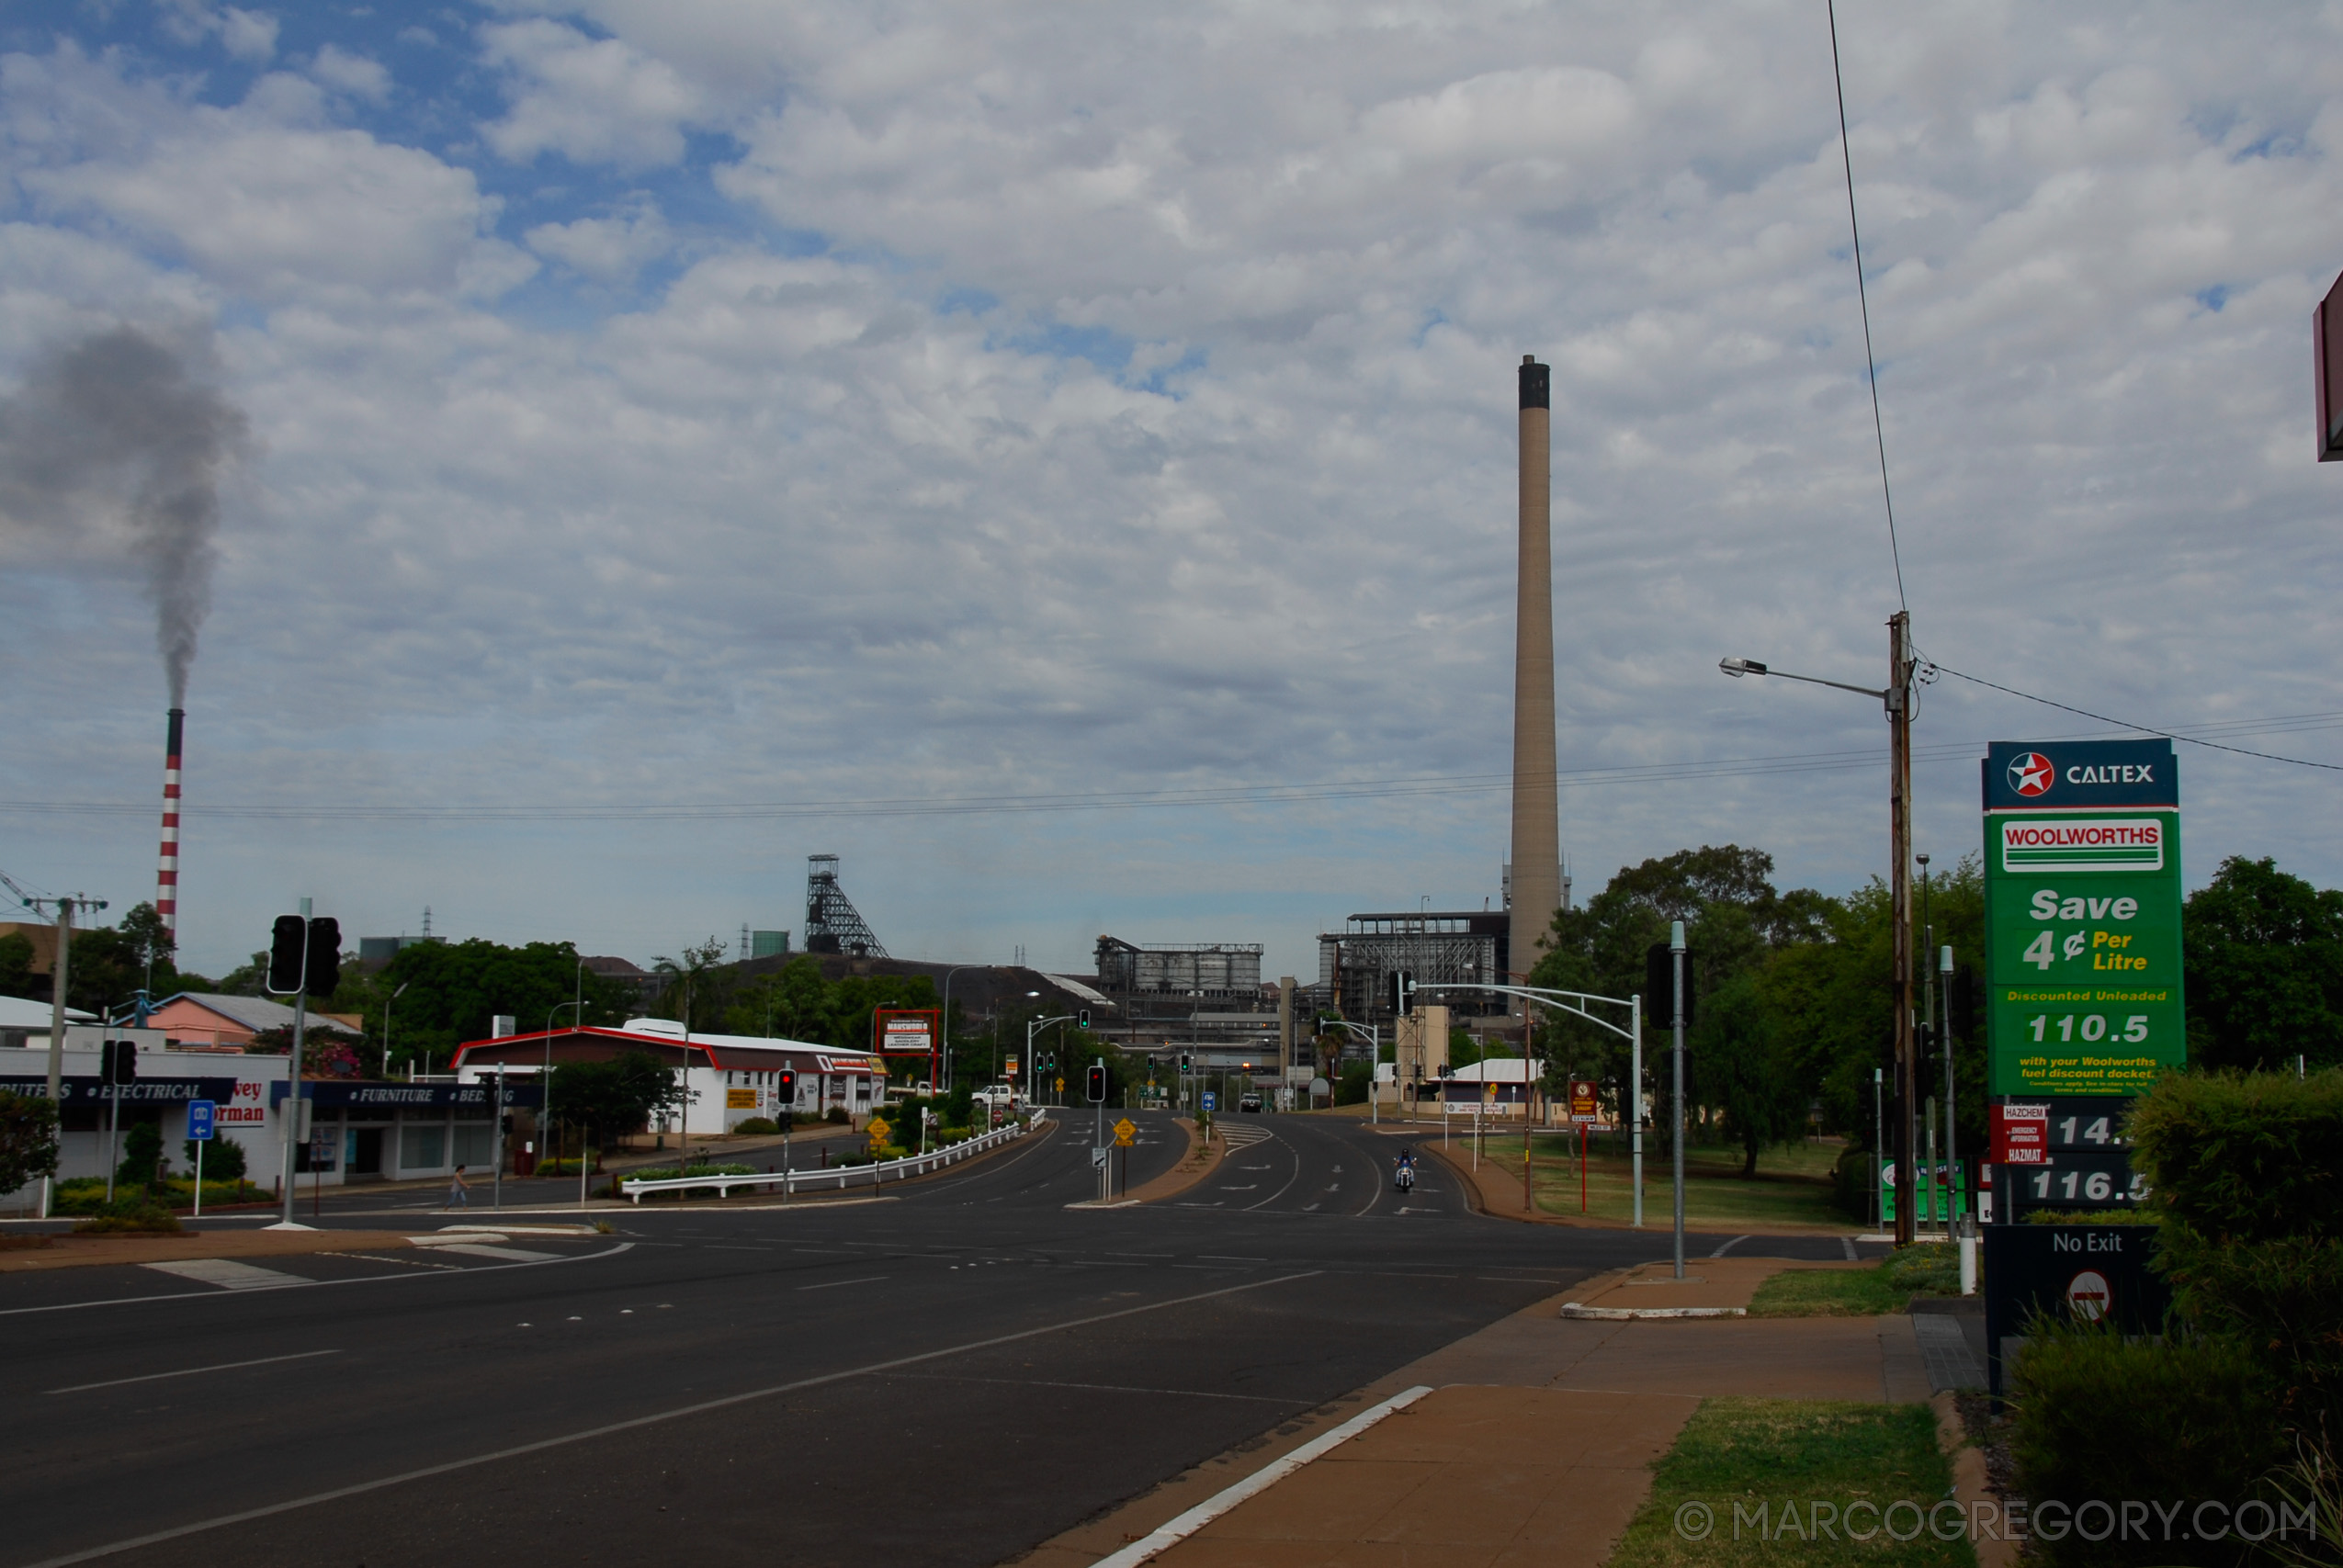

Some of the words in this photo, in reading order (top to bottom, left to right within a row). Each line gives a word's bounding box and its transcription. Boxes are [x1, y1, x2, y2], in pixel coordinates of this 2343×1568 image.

[2066, 764, 2154, 784] CALTEX
[2006, 828, 2158, 845] WOOLWORTHS
[2029, 889, 2139, 920] Save
[2092, 931, 2133, 949] Per
[2093, 953, 2148, 970] Litre
[2008, 990, 2090, 1001] Discounted
[2096, 990, 2167, 1001] Unleaded
[887, 1022, 928, 1033] MANSWORLD
[2030, 1014, 2148, 1043] 110.5
[2020, 1056, 2047, 1066] with
[2050, 1058, 2078, 1068] your
[2082, 1056, 2156, 1066] Woolworths
[2021, 1068, 2046, 1078] fuel
[2049, 1068, 2104, 1078] discount
[233, 1083, 262, 1100] vey
[359, 1089, 434, 1102] FURNITURE
[2006, 1108, 2043, 1118] HAZCHEM
[2009, 1148, 2042, 1162] HAZMAT
[2054, 1233, 2082, 1252] No
[2087, 1232, 2122, 1252] Exit
